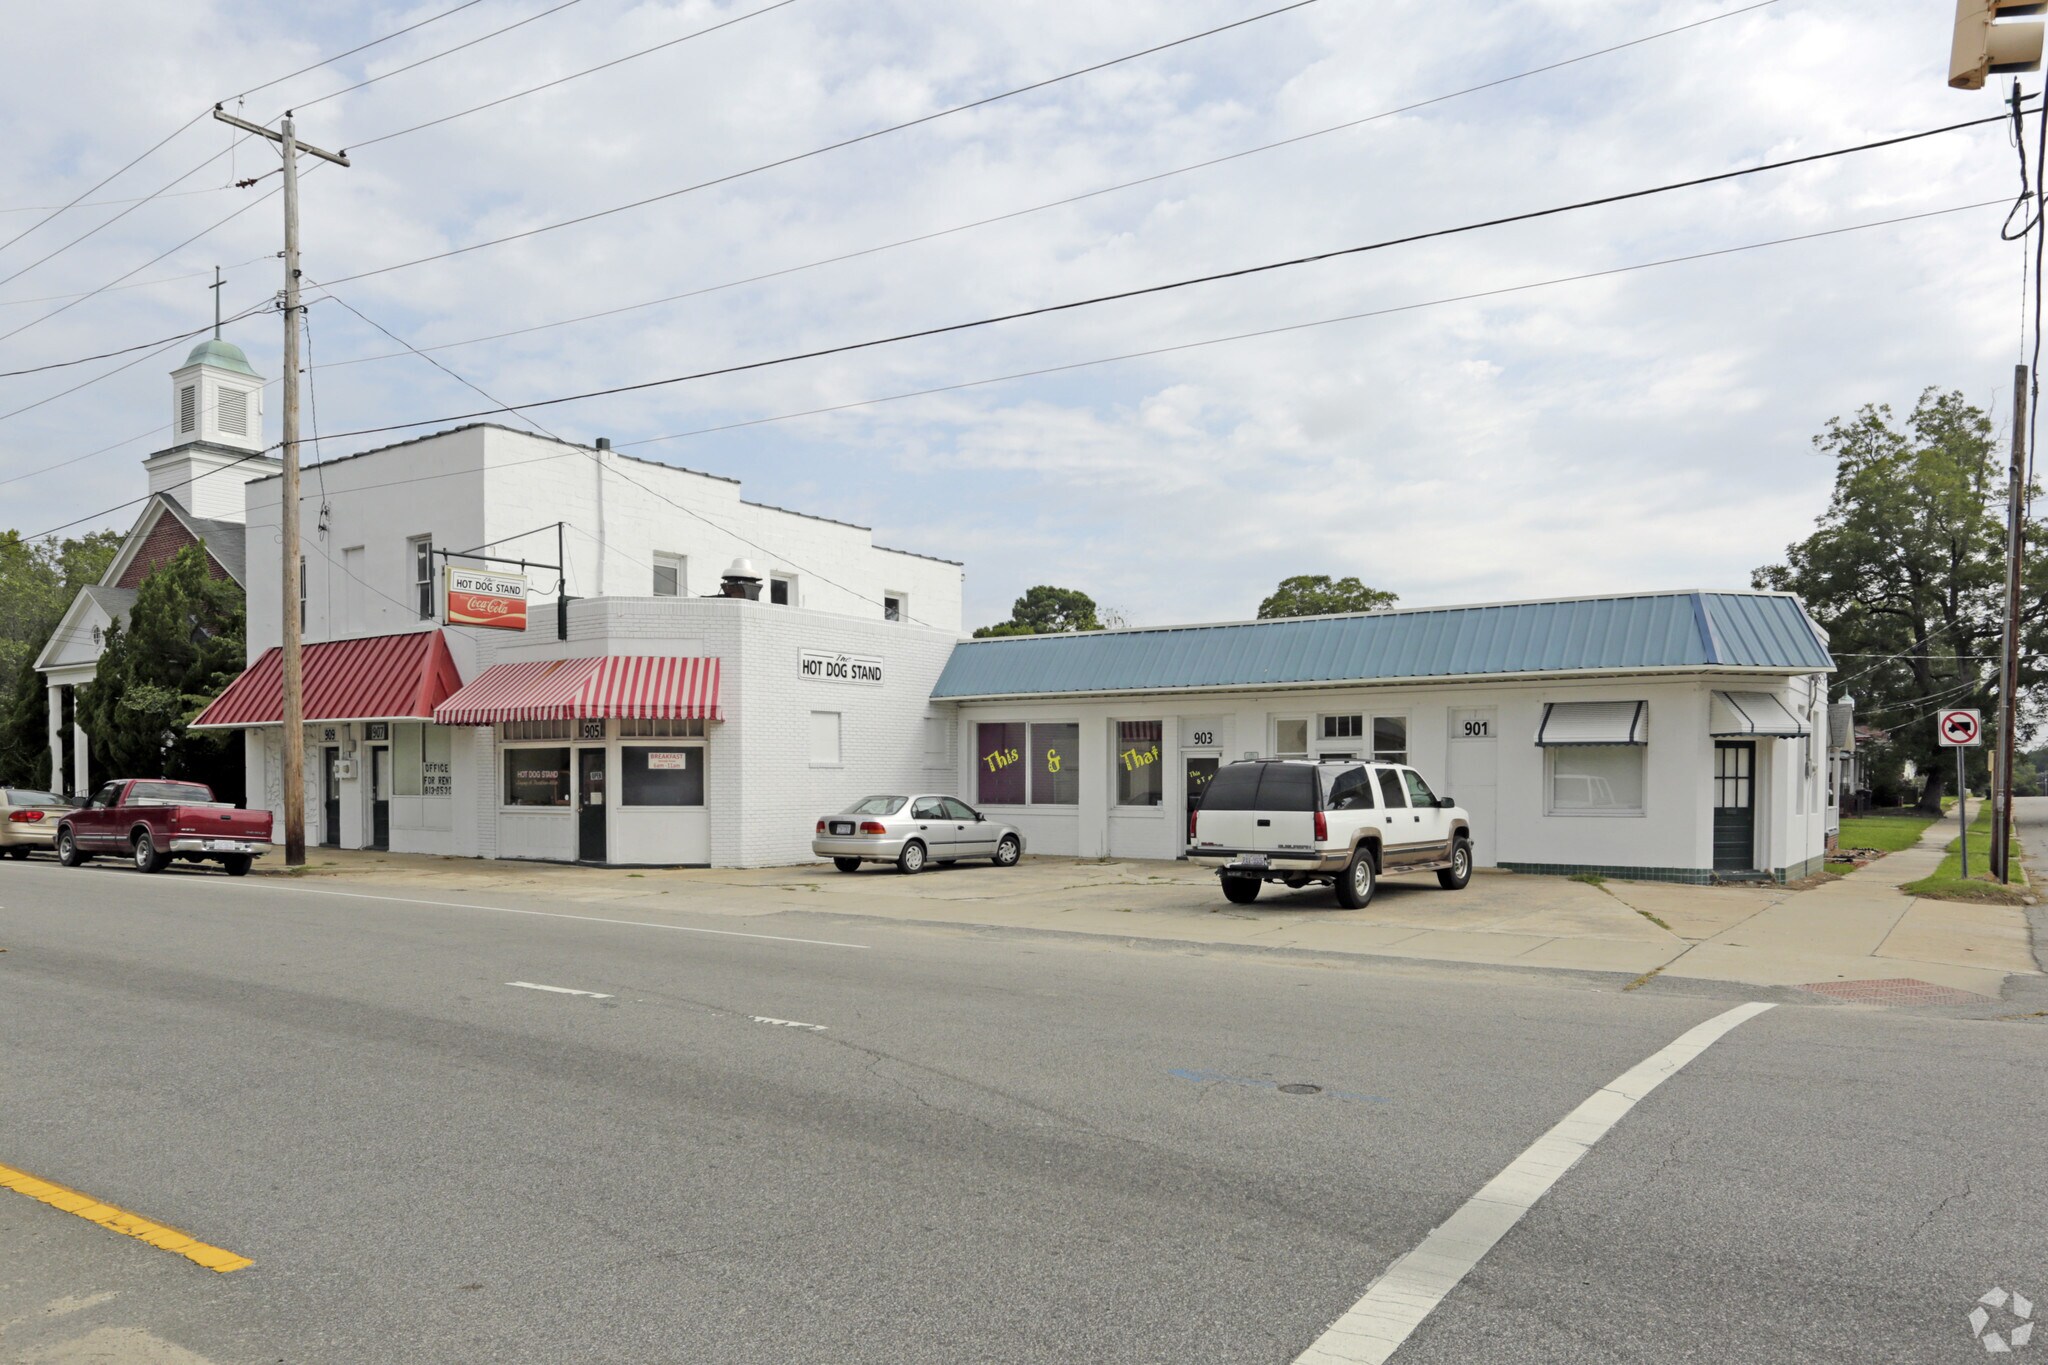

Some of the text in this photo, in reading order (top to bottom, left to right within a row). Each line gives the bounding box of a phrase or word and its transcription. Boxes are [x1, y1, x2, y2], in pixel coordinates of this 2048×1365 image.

[456, 579, 521, 595] HOT DOG STAND
[467, 596, 508, 614] Coca-Cola
[802, 659, 882, 681] HOT DOG STAND
[325, 729, 335, 740] 909
[372, 727, 383, 738] 907
[585, 725, 599, 738] 905
[1464, 721, 1487, 736] 901
[1194, 732, 1213, 745] 903
[983, 745, 1159, 773] This & That
[425, 763, 448, 773] OFFICE
[517, 770, 559, 778] HOT DOG STAND
[424, 776, 435, 785] FOR
